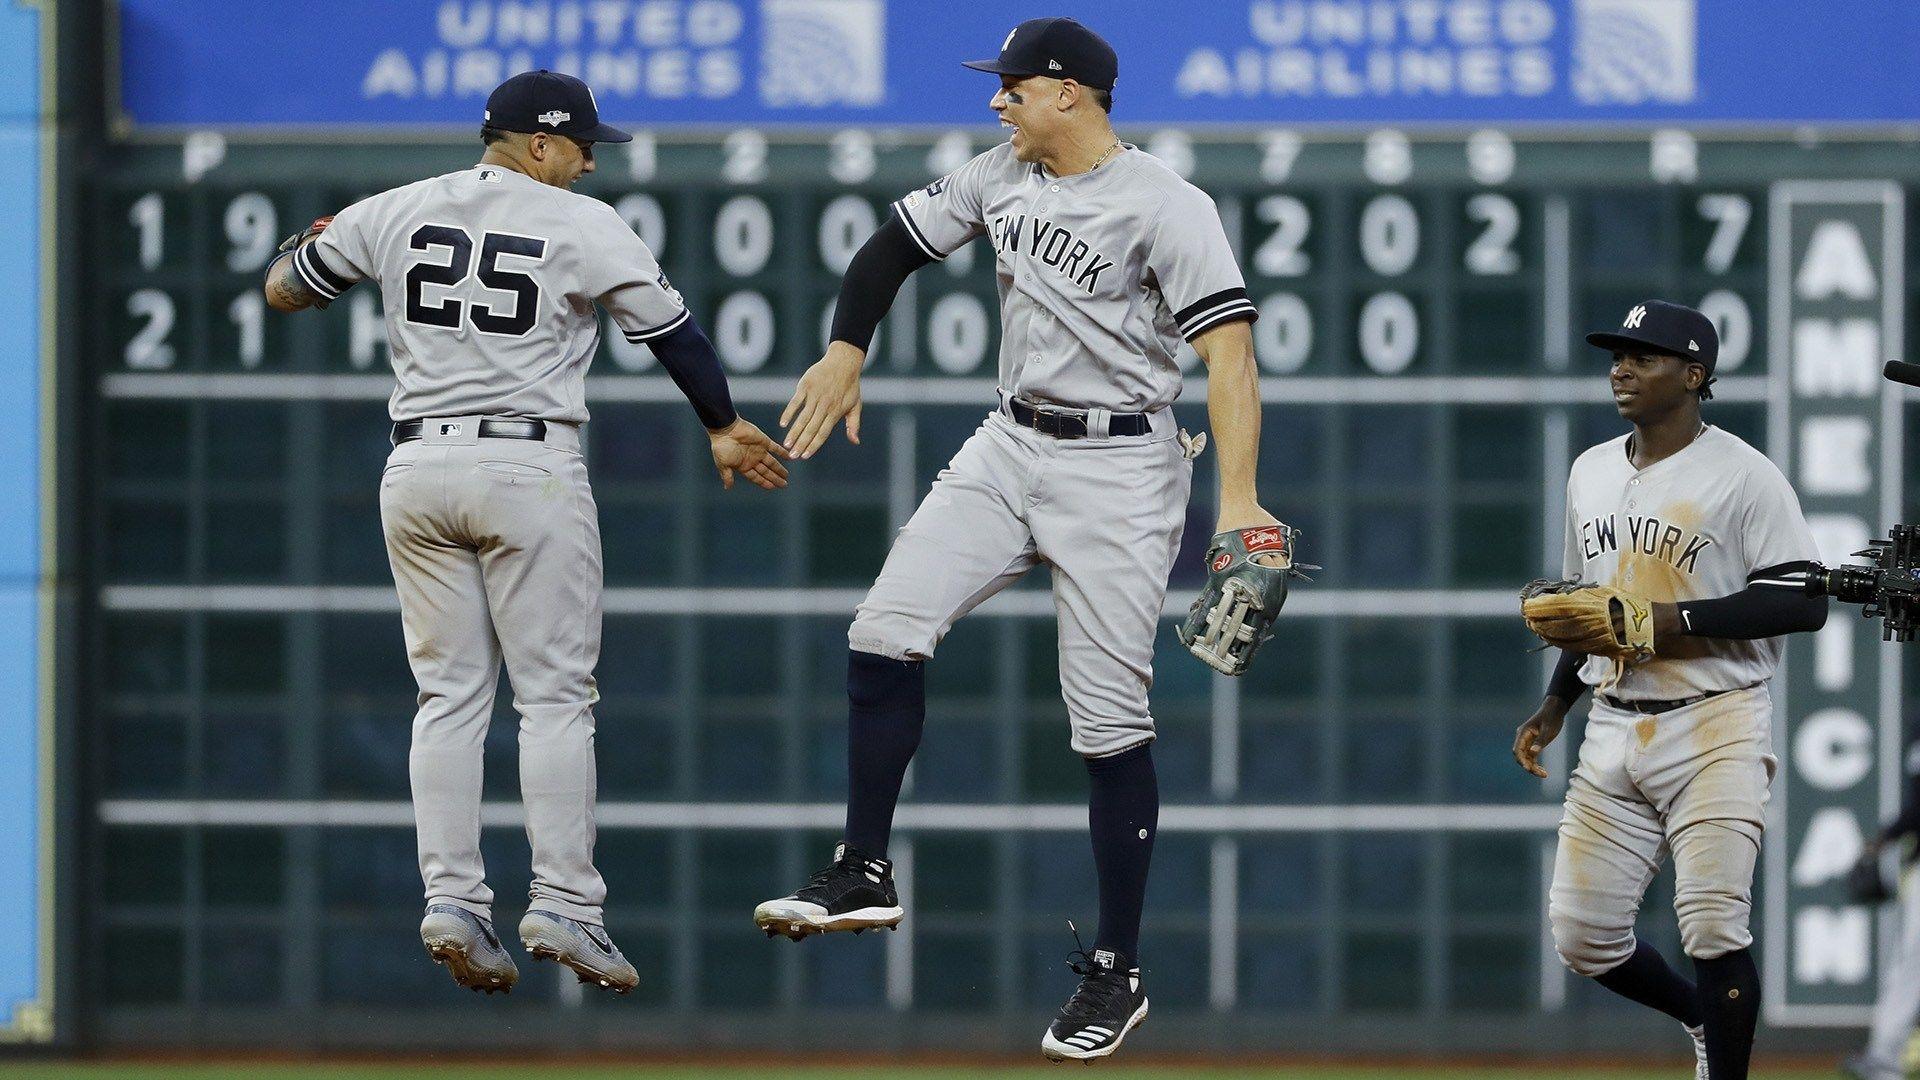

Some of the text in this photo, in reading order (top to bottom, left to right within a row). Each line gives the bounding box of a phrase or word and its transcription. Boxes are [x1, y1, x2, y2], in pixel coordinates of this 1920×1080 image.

[437, 0, 744, 47] UNITED
[1249, 0, 1556, 47] UNITED
[1176, 48, 1556, 97] AIRLINES
[184, 131, 227, 183] P
[713, 195, 774, 278] 0
[818, 194, 878, 276] 0
[1252, 195, 1311, 277] 2
[1359, 195, 1420, 277] 0
[1463, 194, 1521, 276] 2
[1697, 195, 1751, 275] 7
[985, 213, 1025, 255] EW
[1029, 216, 1115, 295] YORK
[405, 221, 549, 338] 25
[713, 290, 776, 374] 0
[928, 291, 989, 376] 0
[1252, 292, 1313, 375] 0
[1357, 291, 1420, 375] 0
[1582, 513, 1711, 575] EW YORK
